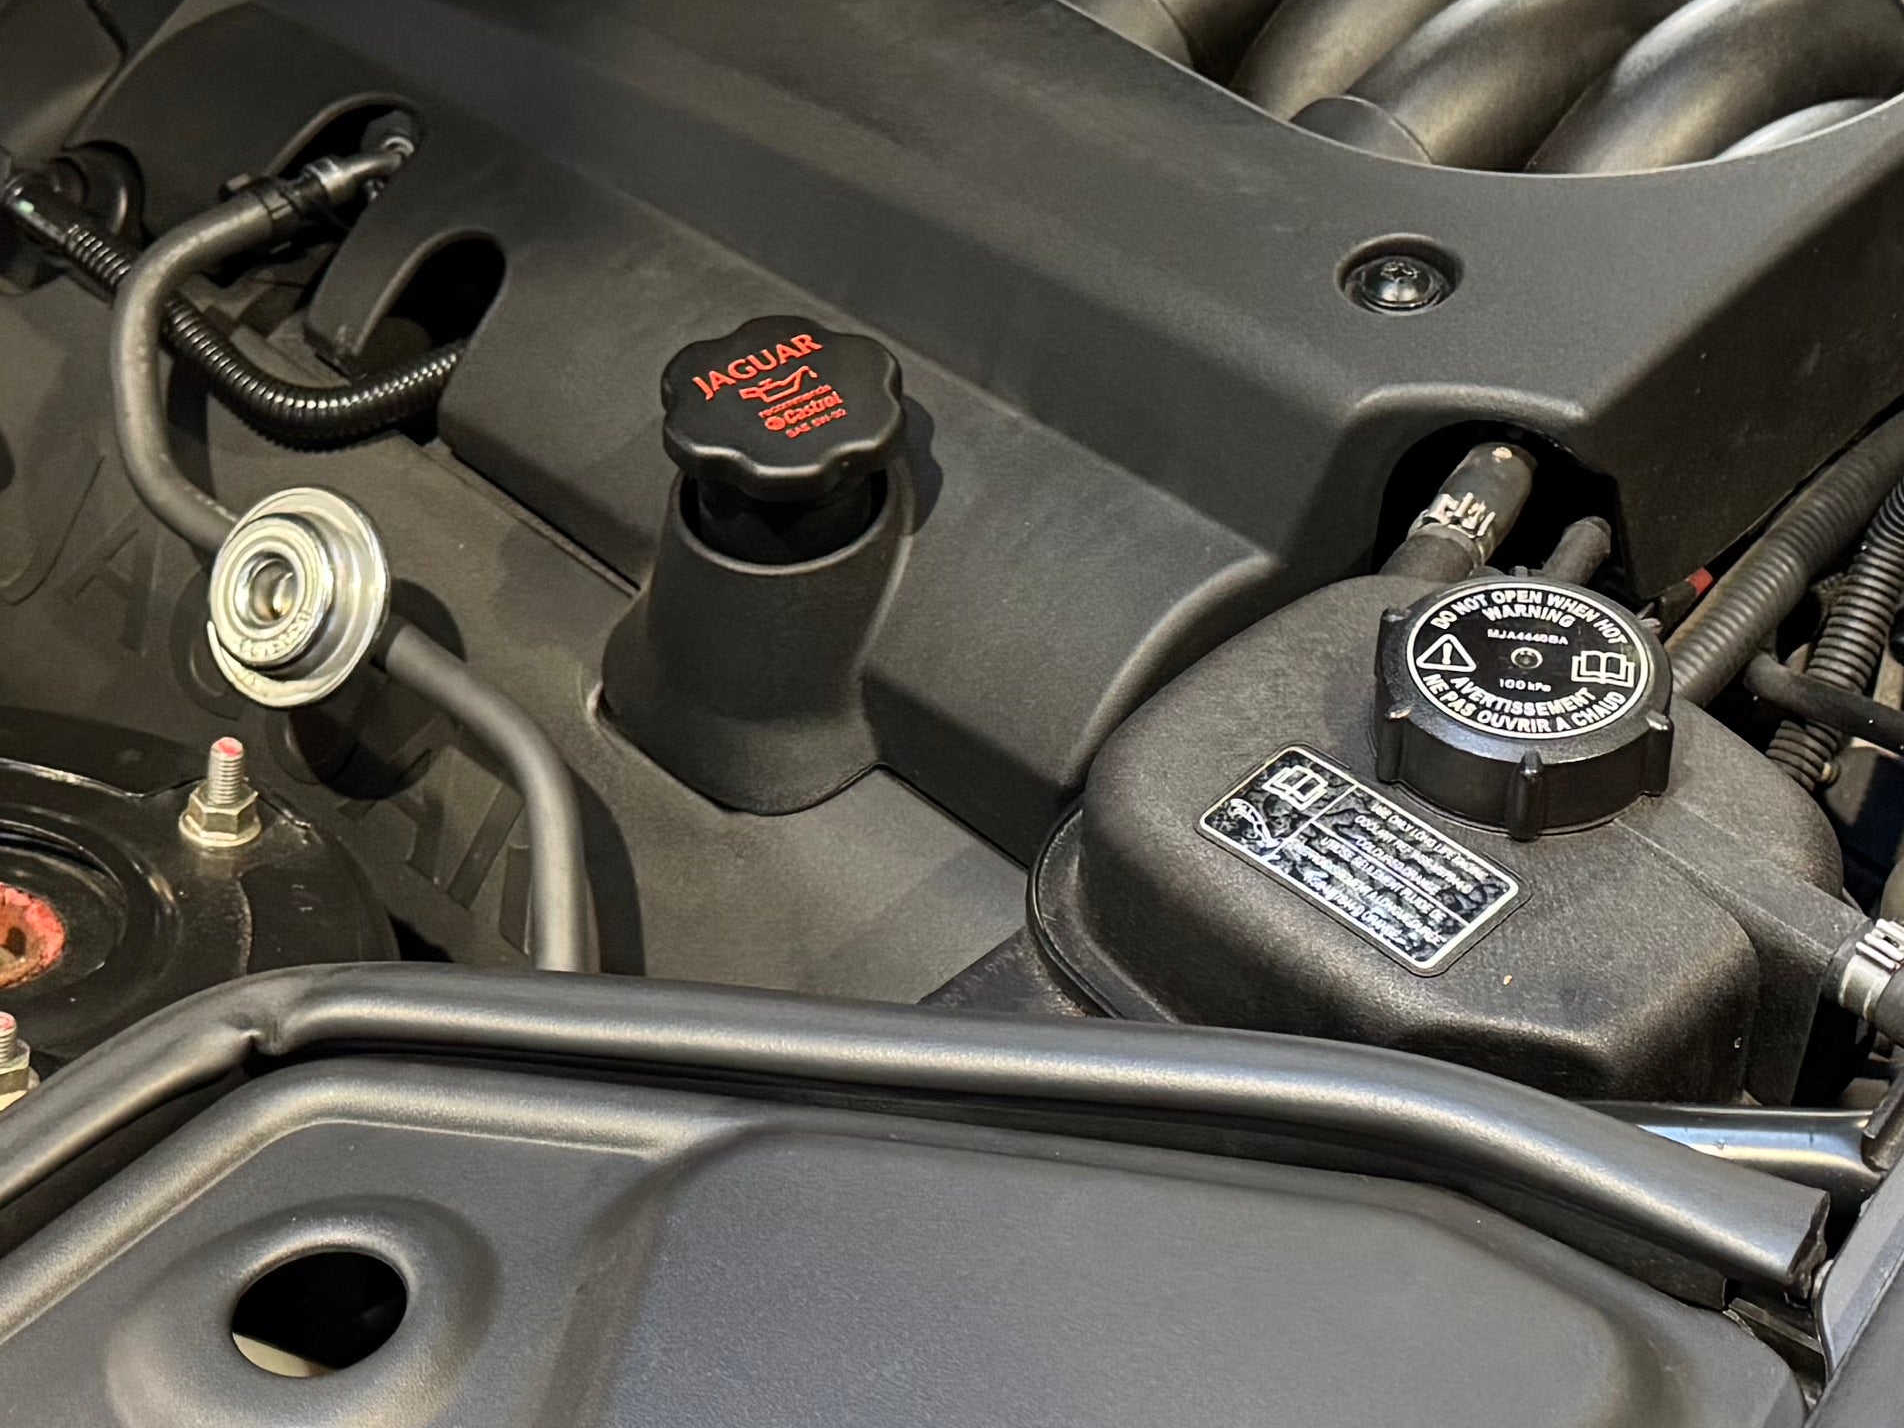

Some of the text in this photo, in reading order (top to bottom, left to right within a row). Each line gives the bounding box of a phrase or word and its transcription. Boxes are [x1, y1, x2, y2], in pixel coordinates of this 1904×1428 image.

[692, 333, 824, 400] JAGUAR
[784, 391, 844, 424] Castrol
[1431, 589, 1628, 646] DO NOT OPEN WHEN HOT
[1483, 604, 1576, 628] WARNING
[1423, 673, 1626, 733] NE PAS OUVRIR A CHAUD
[1450, 676, 1596, 716] AVERTISSEMENT
[1499, 678, 1526, 691] 100
[1352, 814, 1398, 844] COOLANT
[1386, 813, 1415, 833] ONLY
[1408, 827, 1439, 848] LONG
[1432, 842, 1457, 860] LIFE
